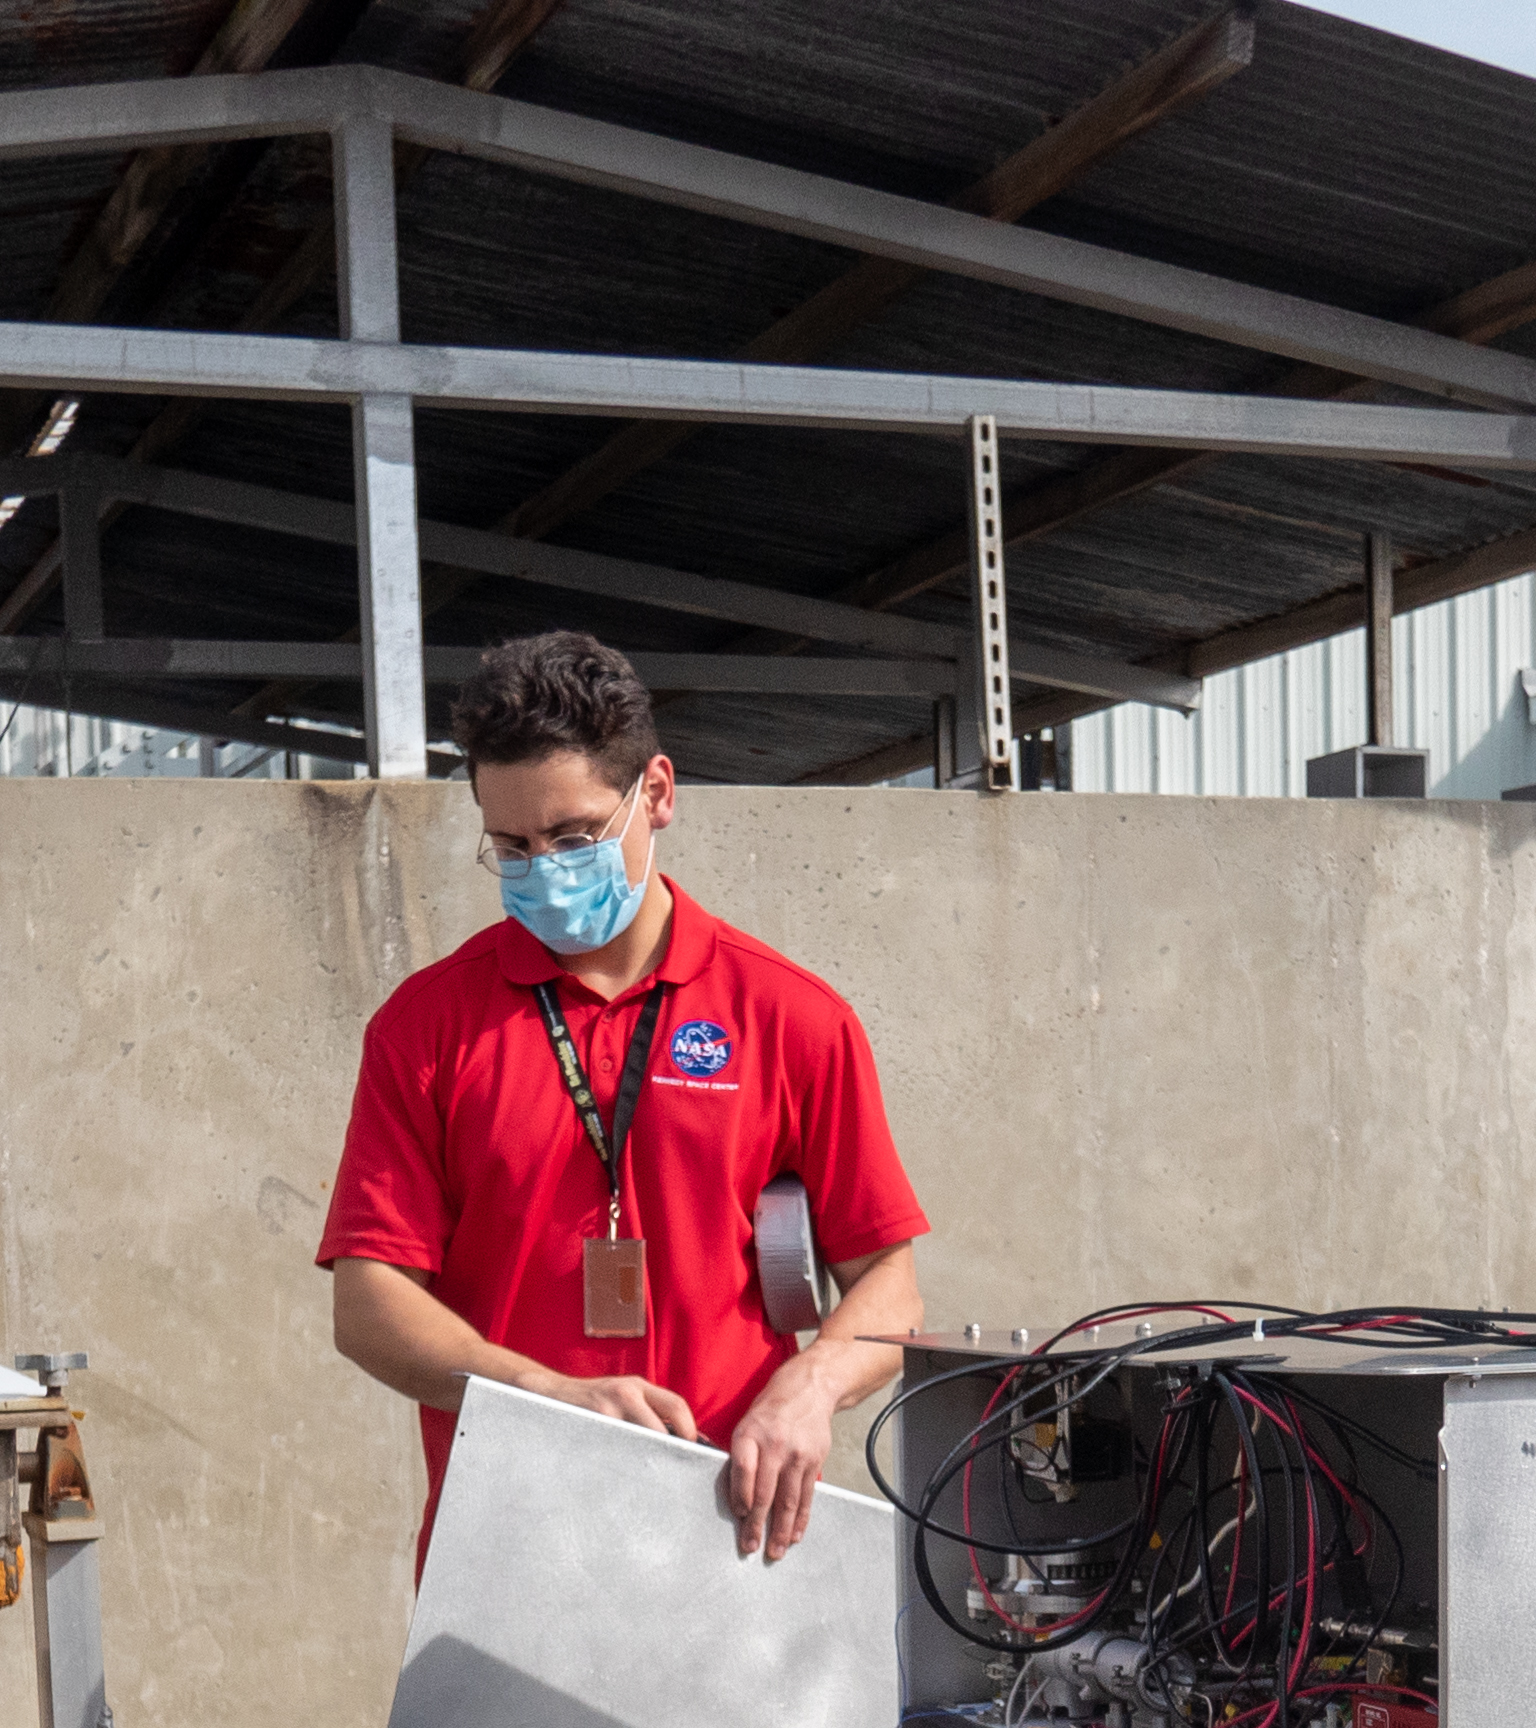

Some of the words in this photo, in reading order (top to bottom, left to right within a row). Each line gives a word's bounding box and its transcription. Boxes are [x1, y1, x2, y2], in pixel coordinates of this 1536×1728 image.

[674, 1038, 728, 1059] NASA
[652, 1075, 684, 1087] KENNEDY
[686, 1079, 710, 1089] SPACE
[710, 1082, 739, 1091] CENTER
